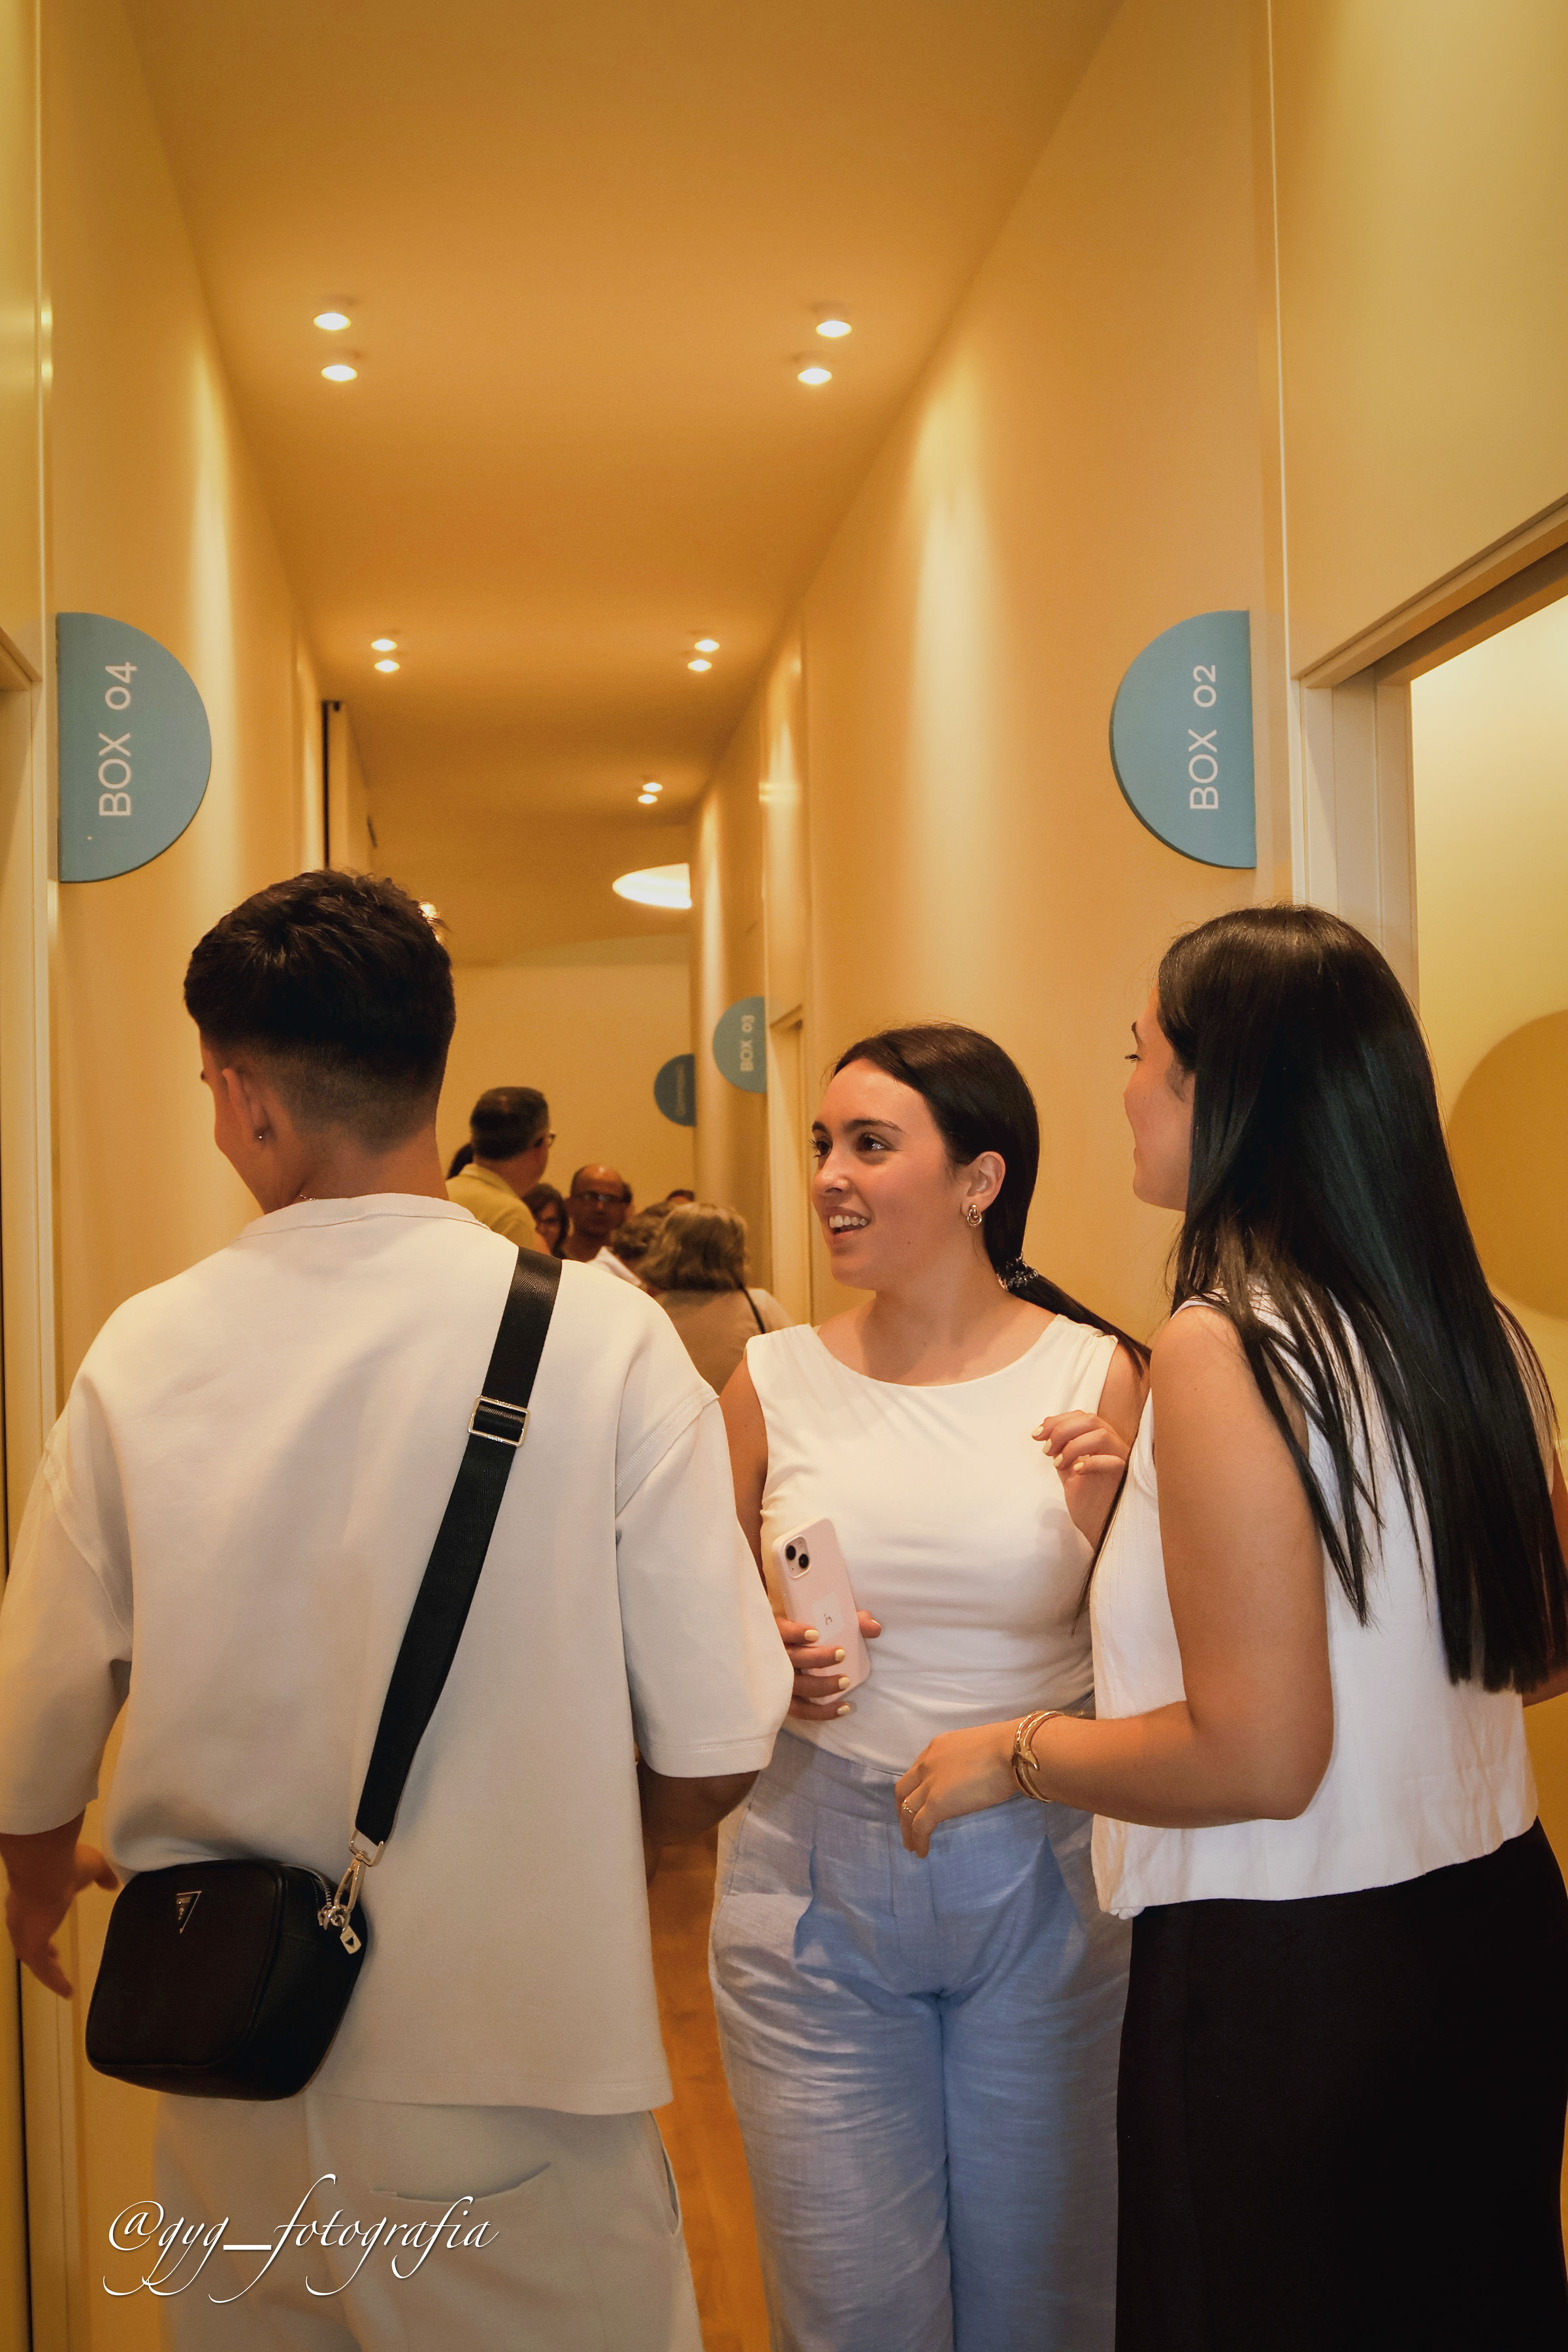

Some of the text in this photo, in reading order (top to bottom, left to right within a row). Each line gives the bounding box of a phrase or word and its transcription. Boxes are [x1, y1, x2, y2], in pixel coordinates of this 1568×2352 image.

[98, 661, 138, 817] BOX 04
[1188, 664, 1219, 810] BOX 02
[740, 1014, 755, 1072] BOX 03
